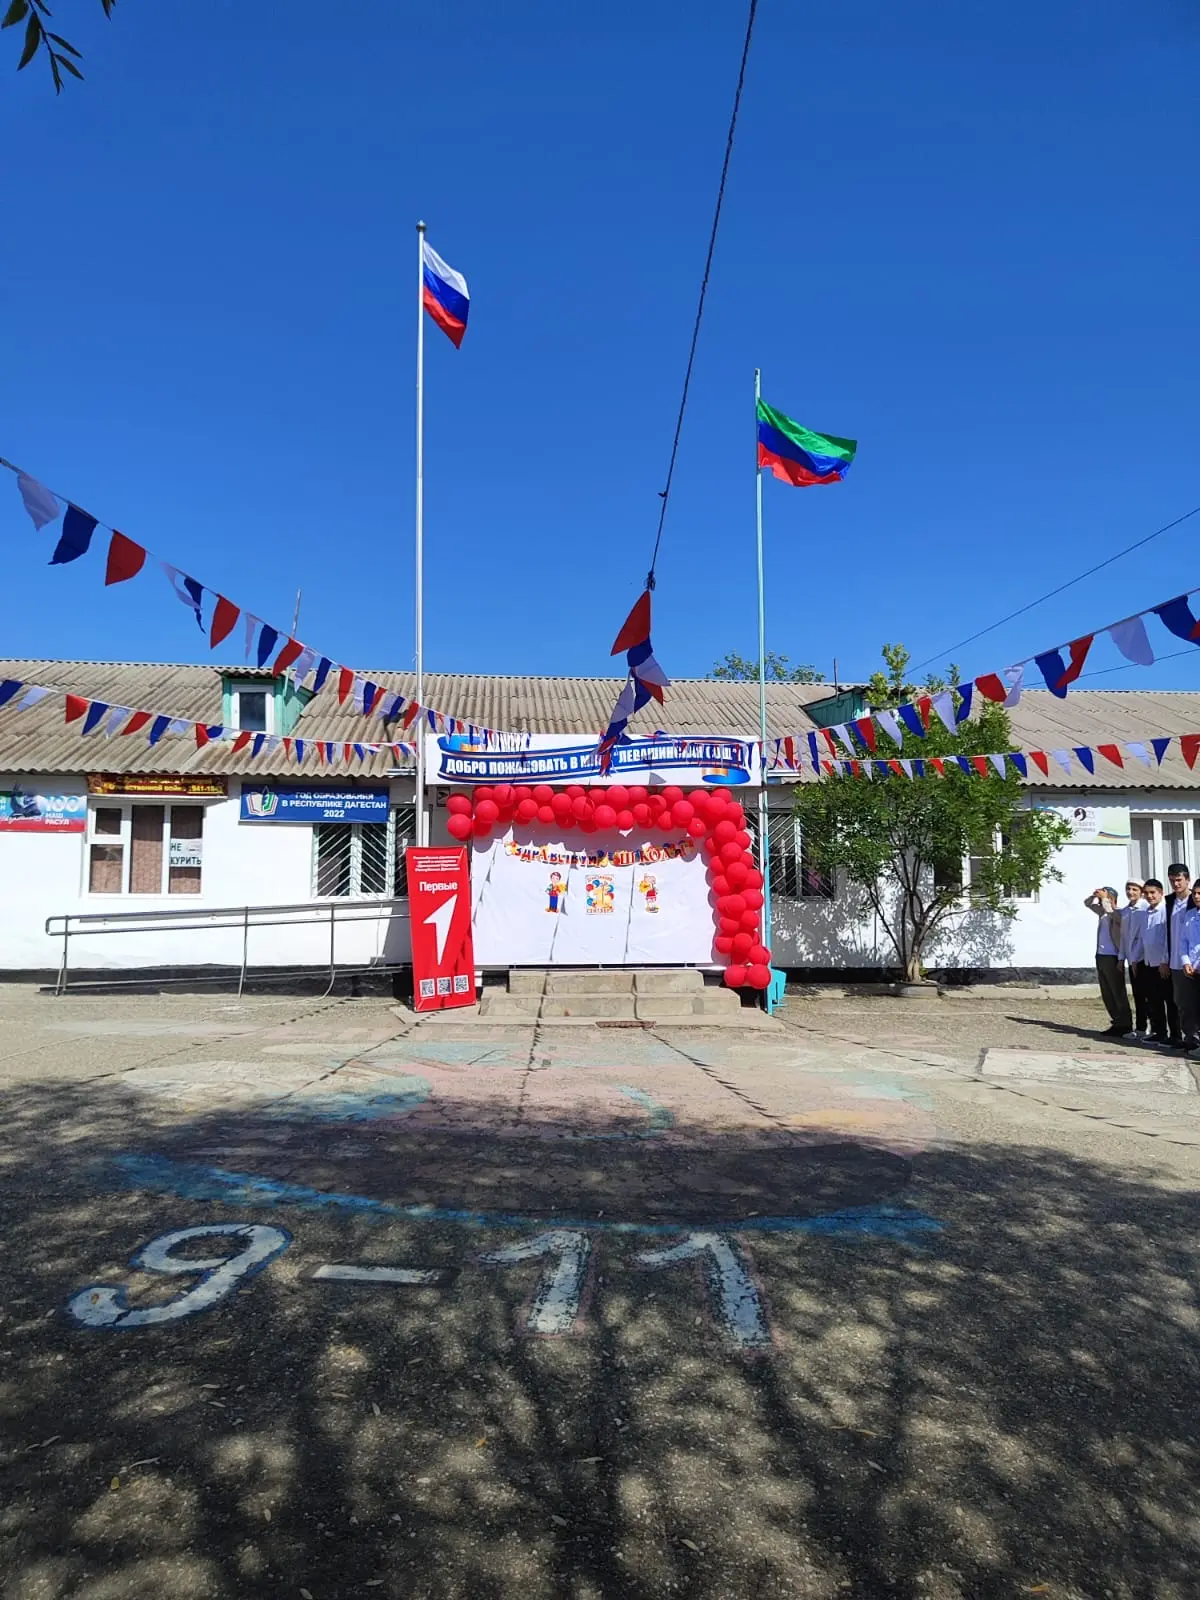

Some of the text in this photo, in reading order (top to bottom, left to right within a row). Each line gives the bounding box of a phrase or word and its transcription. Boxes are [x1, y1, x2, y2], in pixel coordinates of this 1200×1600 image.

[446, 758, 486, 774] ДОБРО
[489, 757, 567, 775] ПОЖАЛОВАТЬ
[570, 756, 578, 769] В
[290, 800, 343, 808] РЕСПУБЛИКЕ
[344, 801, 387, 809] ДАГЕСТАН
[323, 809, 345, 818] 2022
[170, 843, 182, 851] НЕ
[170, 856, 202, 865] КУРИТЬ
[419, 881, 458, 894] Первые
